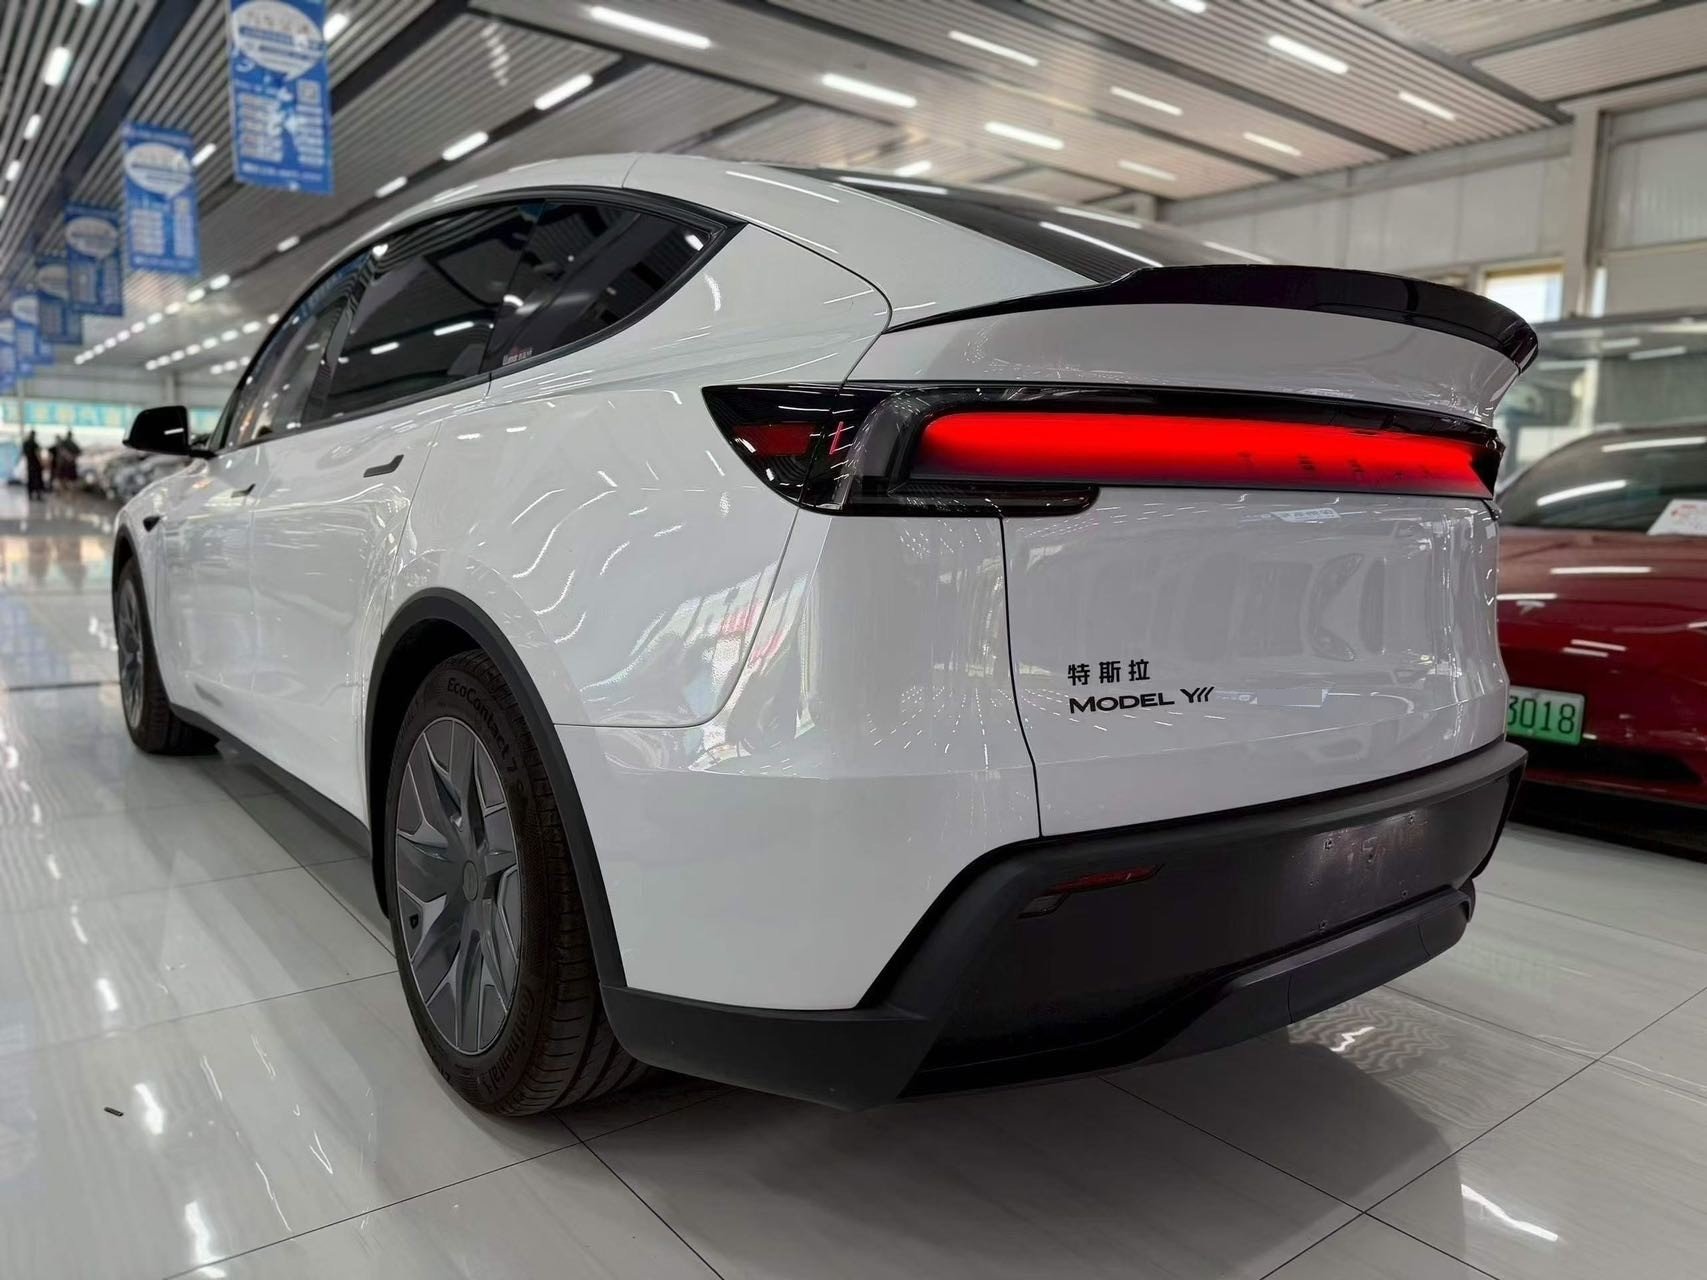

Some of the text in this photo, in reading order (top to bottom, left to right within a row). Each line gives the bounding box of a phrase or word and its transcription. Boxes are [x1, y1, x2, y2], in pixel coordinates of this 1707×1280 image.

[1067, 659, 1150, 686] 特斯拉
[1069, 692, 1175, 714] MODEL
[1507, 694, 1576, 734] 3018
